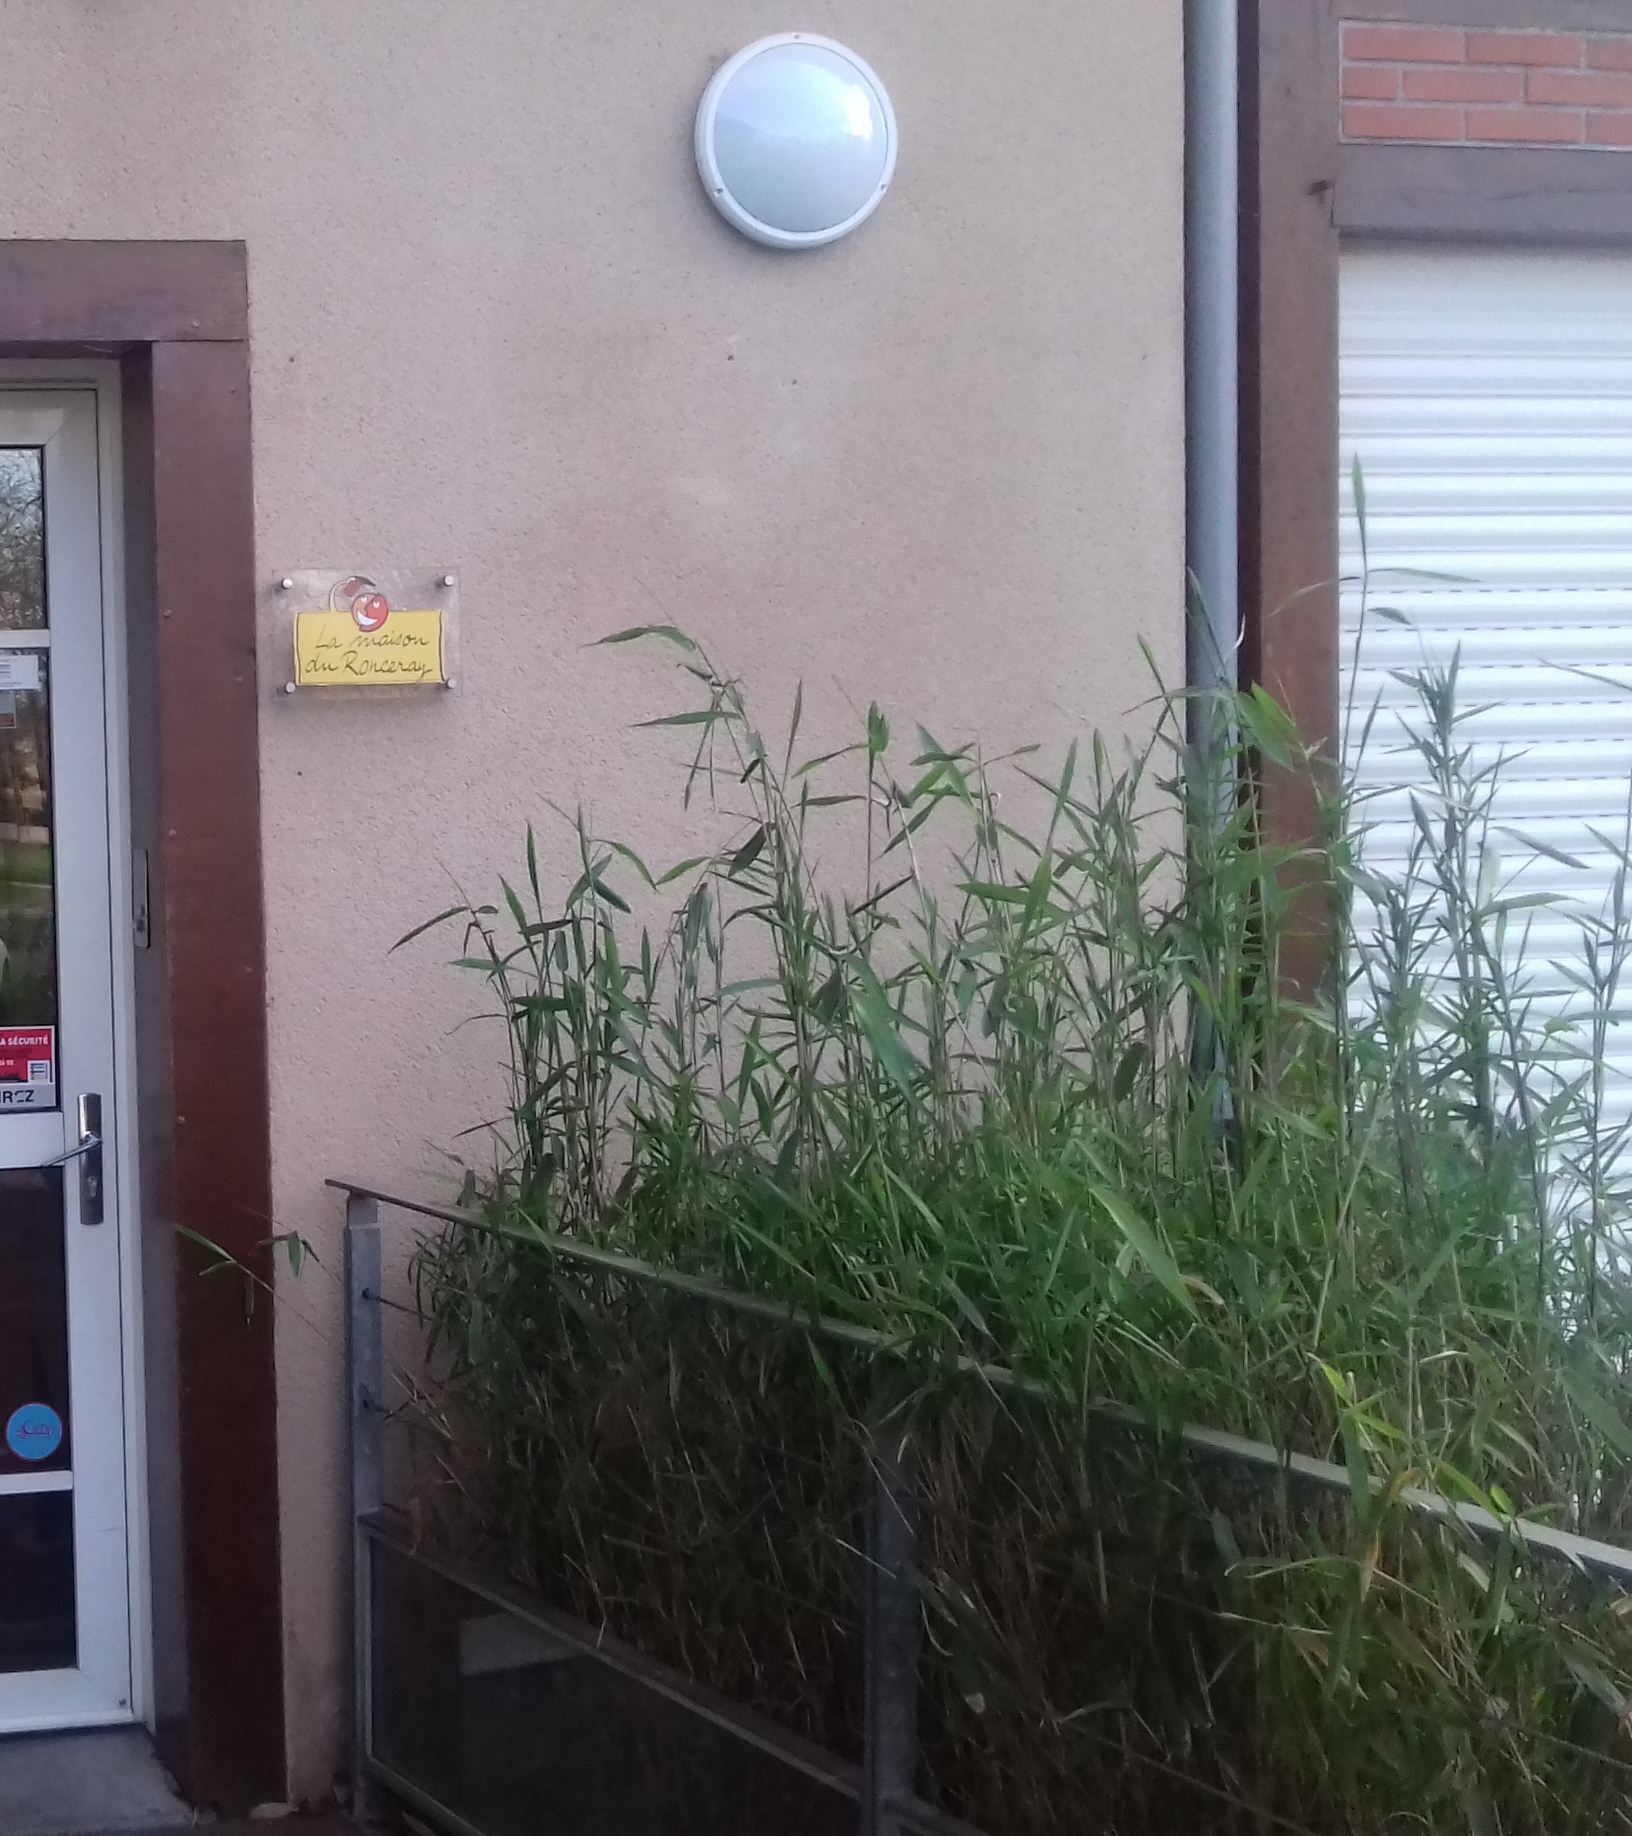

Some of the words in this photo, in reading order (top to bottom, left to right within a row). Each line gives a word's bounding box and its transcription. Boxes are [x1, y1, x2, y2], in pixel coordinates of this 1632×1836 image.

[316, 624, 342, 649] La
[349, 630, 430, 649] maison
[305, 652, 339, 674] du
[340, 650, 433, 679] Ronceray
